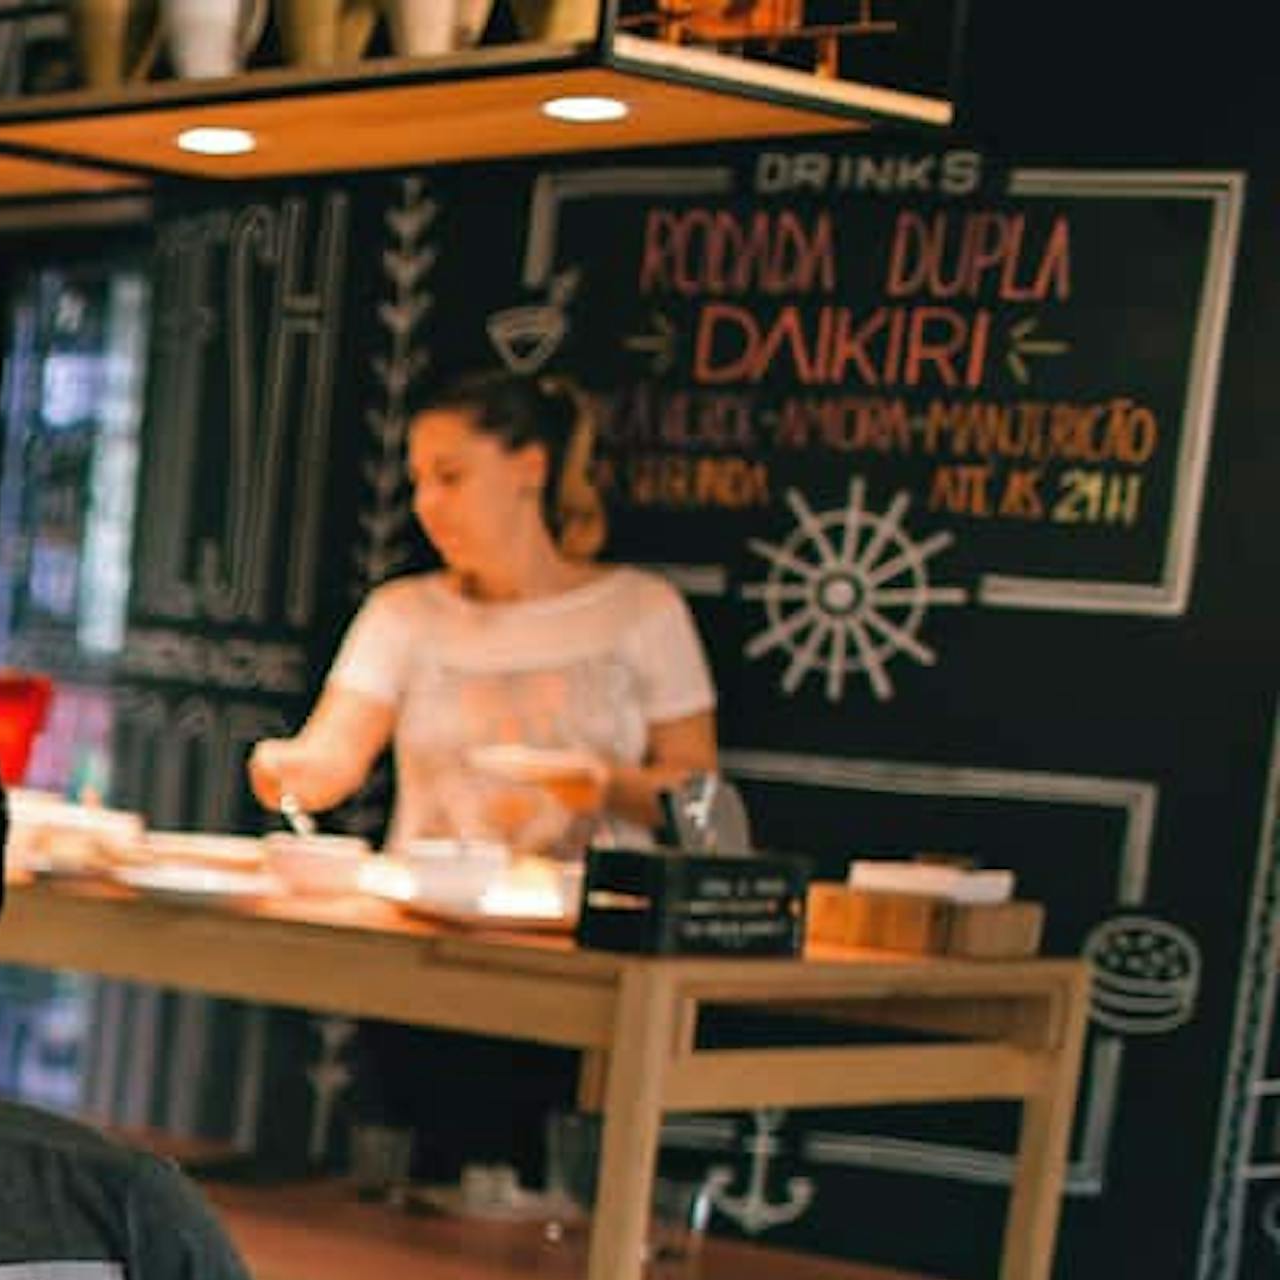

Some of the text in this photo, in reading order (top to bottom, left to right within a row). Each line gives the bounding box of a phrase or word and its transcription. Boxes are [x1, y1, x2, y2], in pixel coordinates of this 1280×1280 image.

[752, 150, 984, 196] DRINKS
[642, 206, 1072, 302] RODADA DUPLA
[693, 303, 991, 388] DAIKIRI
